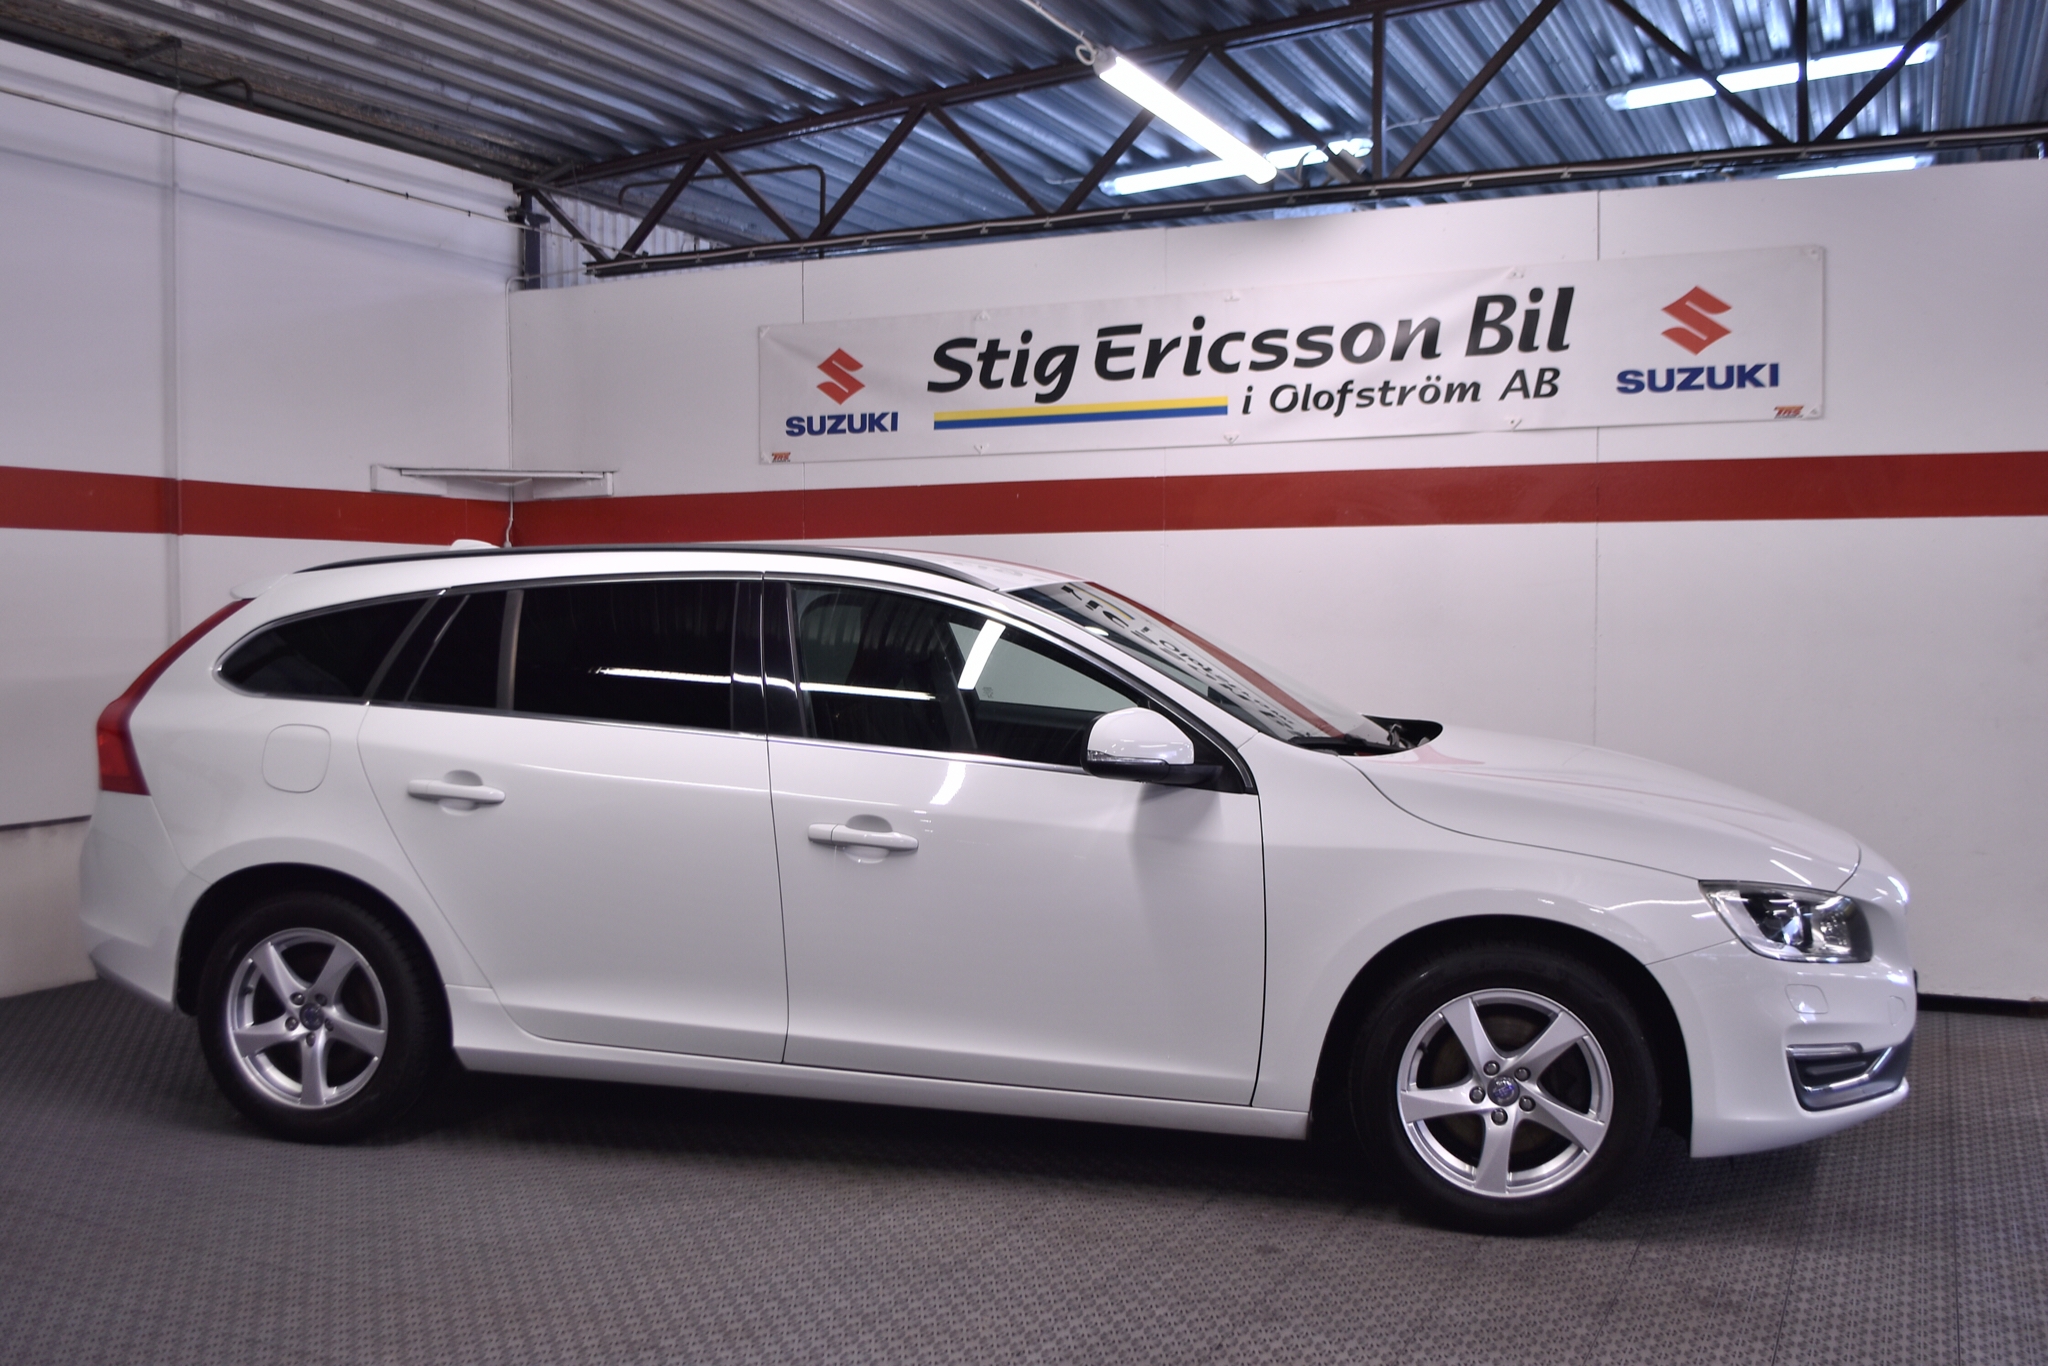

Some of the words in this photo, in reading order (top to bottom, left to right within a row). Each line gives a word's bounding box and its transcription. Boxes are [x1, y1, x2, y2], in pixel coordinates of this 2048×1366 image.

[926, 329, 1080, 405] Stig
[1094, 315, 1442, 382] Ericsson
[1465, 286, 1575, 357] Bil
[1242, 385, 1254, 415] i
[1269, 375, 1482, 418] Olofström
[1498, 367, 1561, 401] AB
[1616, 362, 1780, 395] SUZUKI
[785, 411, 899, 438] SUZUKI
